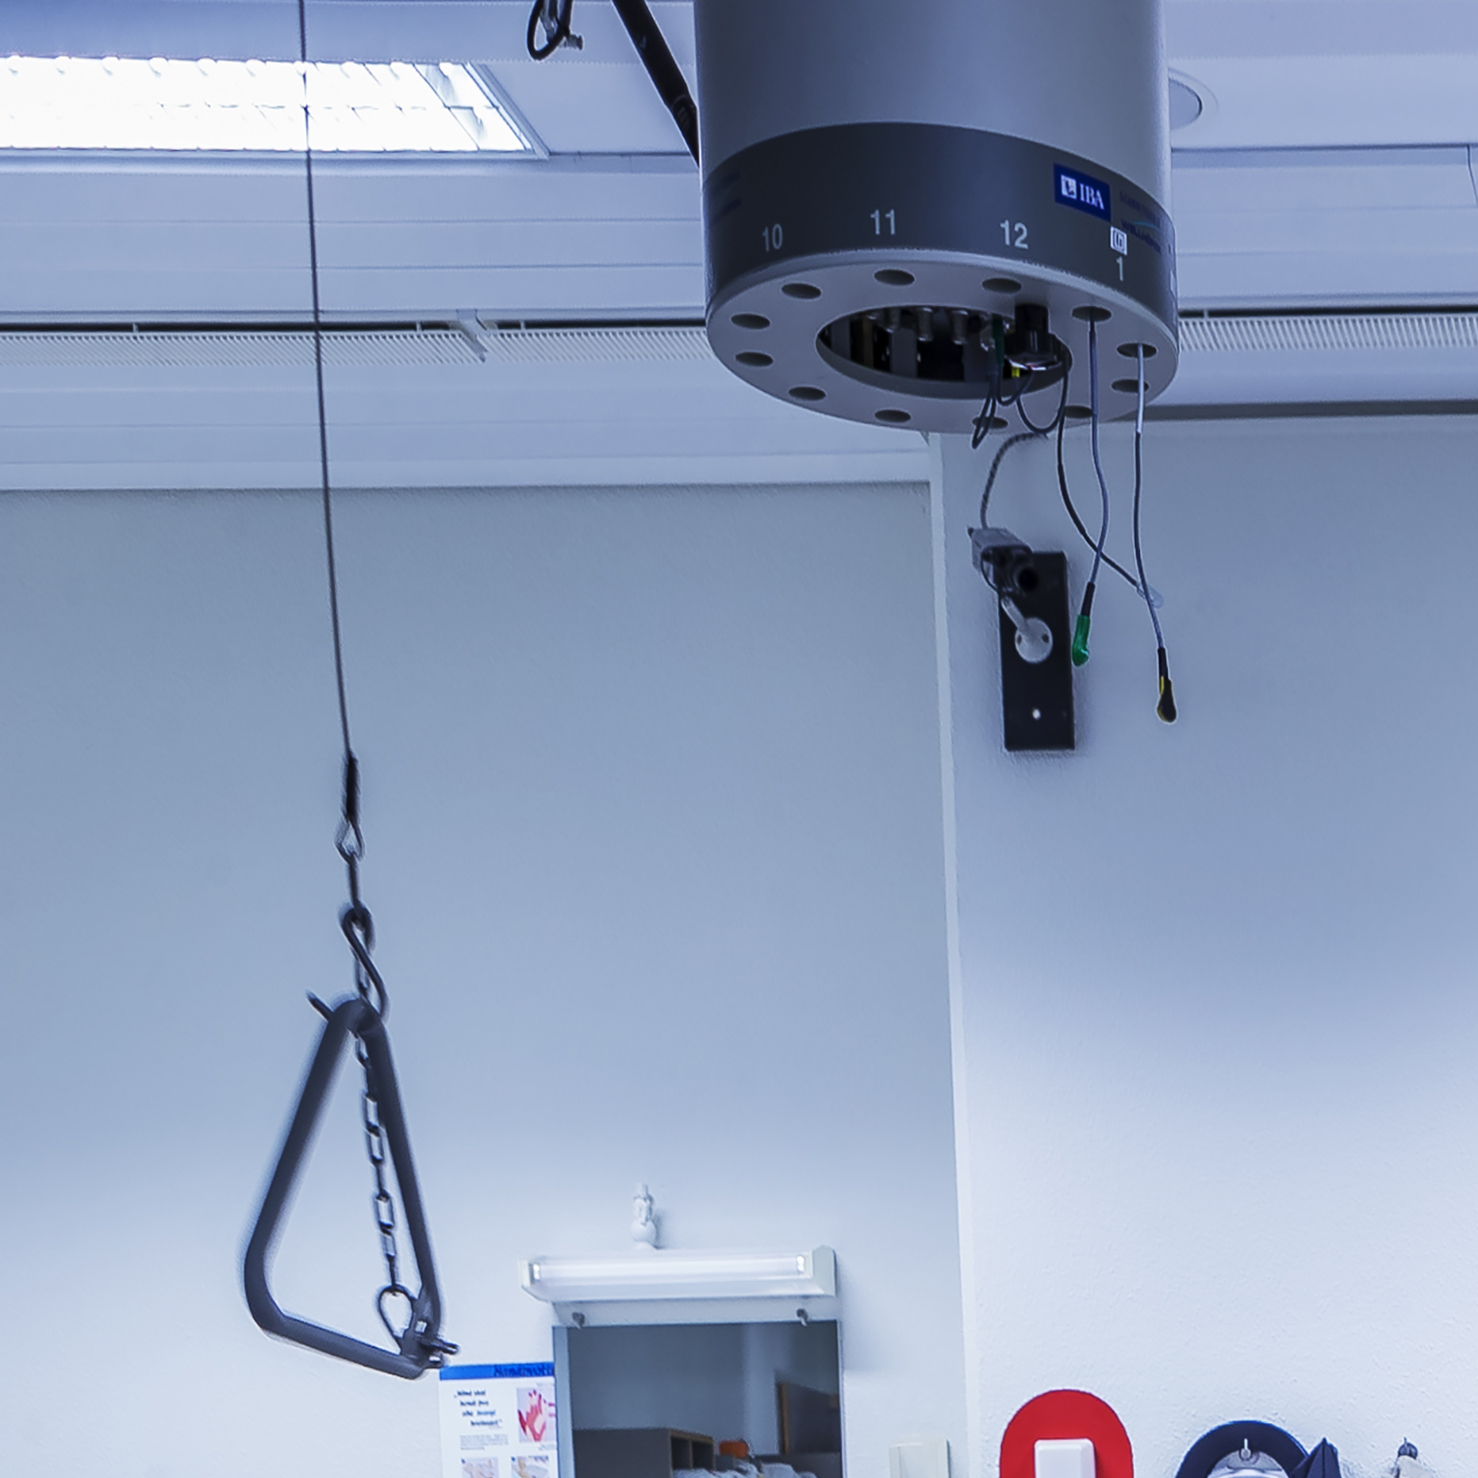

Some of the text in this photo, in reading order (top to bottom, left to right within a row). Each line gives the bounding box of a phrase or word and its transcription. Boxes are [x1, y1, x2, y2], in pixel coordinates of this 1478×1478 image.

[1079, 182, 1105, 210] IBA
[870, 209, 897, 236] 11
[1000, 220, 1029, 250] 12
[762, 223, 783, 252] 10
[1116, 255, 1124, 282] 1
